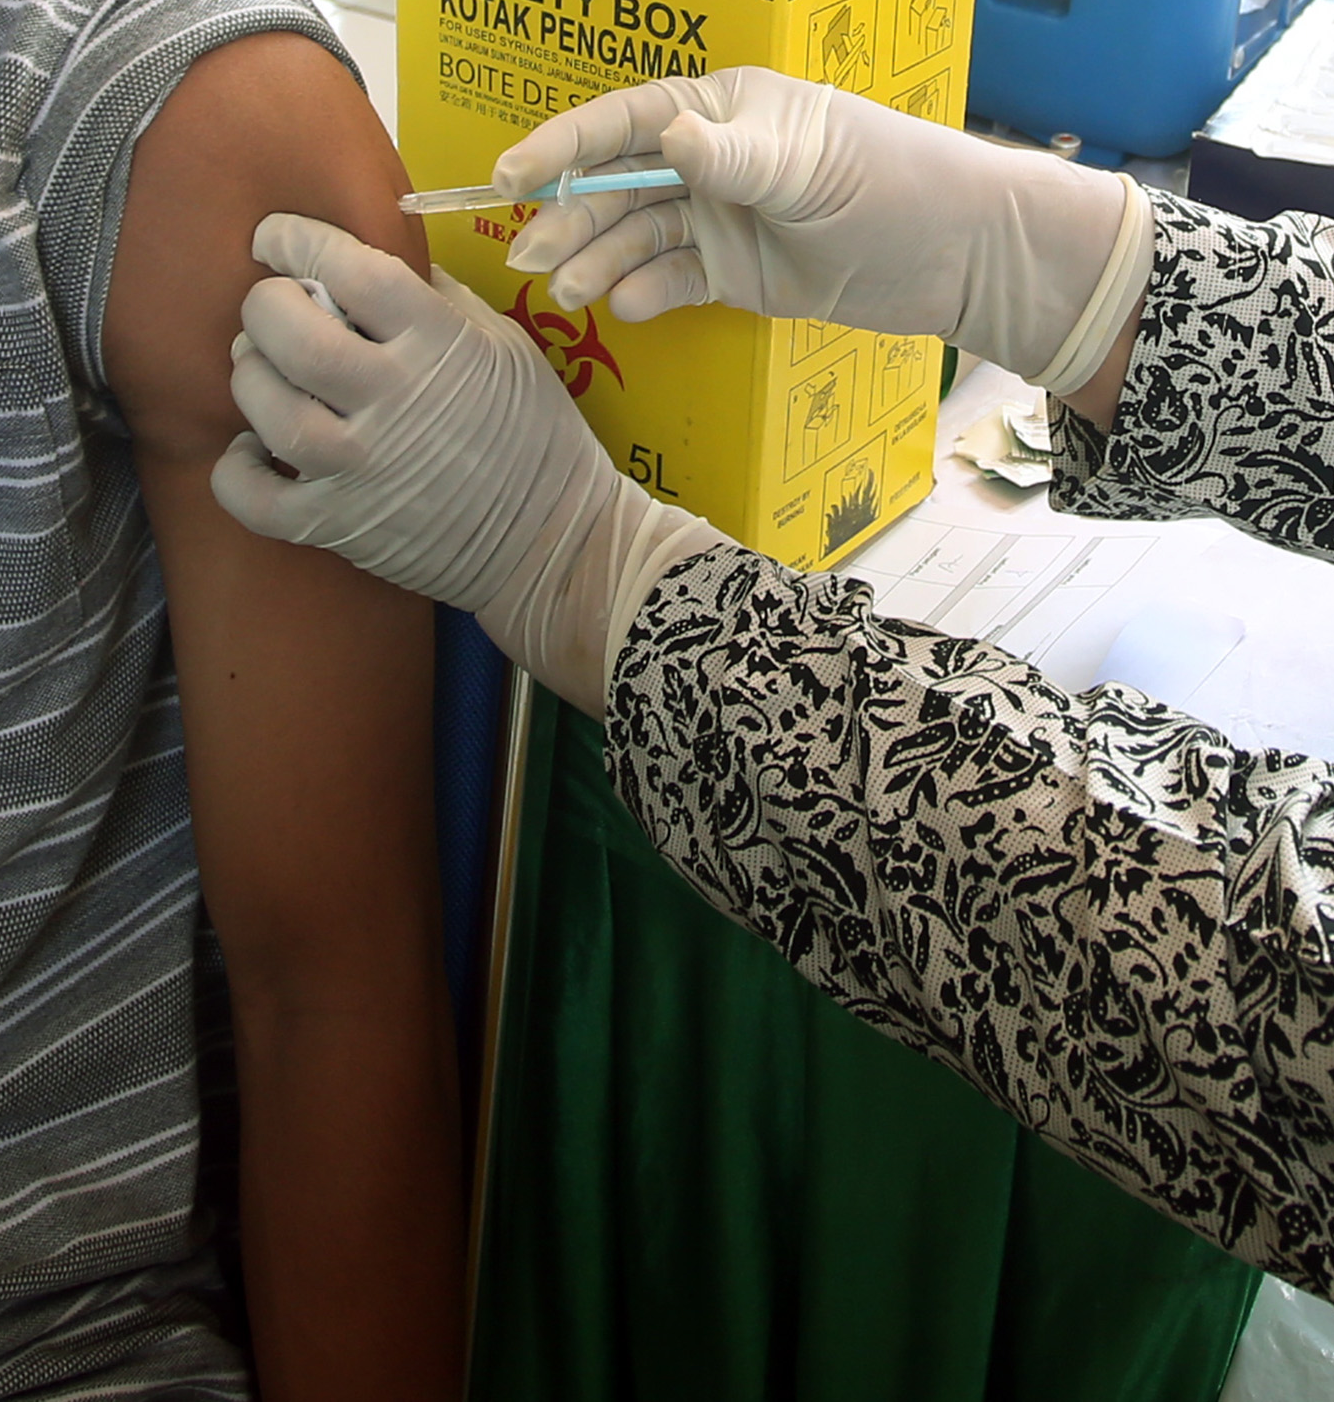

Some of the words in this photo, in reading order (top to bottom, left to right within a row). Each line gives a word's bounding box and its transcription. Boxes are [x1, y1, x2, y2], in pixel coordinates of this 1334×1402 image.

[439, 17, 462, 34] FOR
[465, 26, 496, 44] USED
[565, 57, 620, 83] NEEDLES
[541, 11, 706, 79] PENGAMAN
[440, 52, 514, 99] BOITE
[524, 79, 559, 114] DE
[628, 443, 679, 498] 5L
